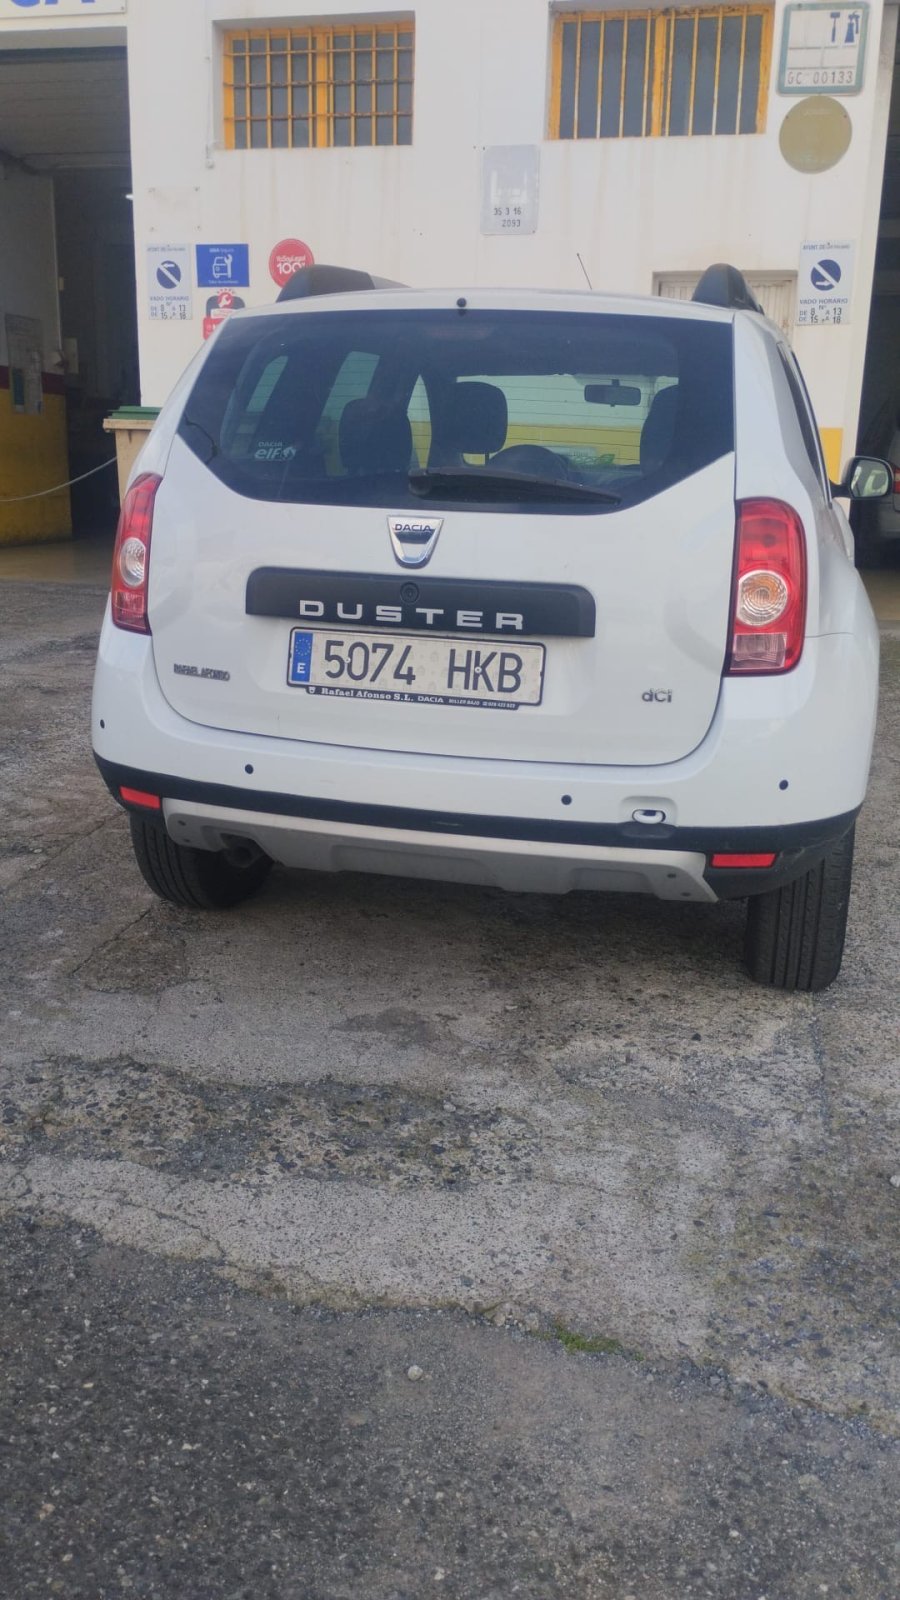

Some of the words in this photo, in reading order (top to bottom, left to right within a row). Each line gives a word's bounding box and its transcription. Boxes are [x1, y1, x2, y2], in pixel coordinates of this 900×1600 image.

[787, 71, 803, 85] GC
[813, 70, 853, 84] 00133
[833, 307, 842, 316] 13
[811, 315, 818, 324] 15
[254, 447, 282, 460] elf
[394, 523, 432, 532] DACIA
[299, 599, 524, 631] DUSTER
[296, 662, 306, 675] E
[324, 639, 416, 686] 5074
[446, 648, 524, 694] HKB
[321, 687, 354, 697] Rafael
[356, 689, 392, 700] Afonso
[393, 693, 414, 702] S.L.
[417, 695, 444, 704] DACIA
[641, 688, 672, 703] dCi
